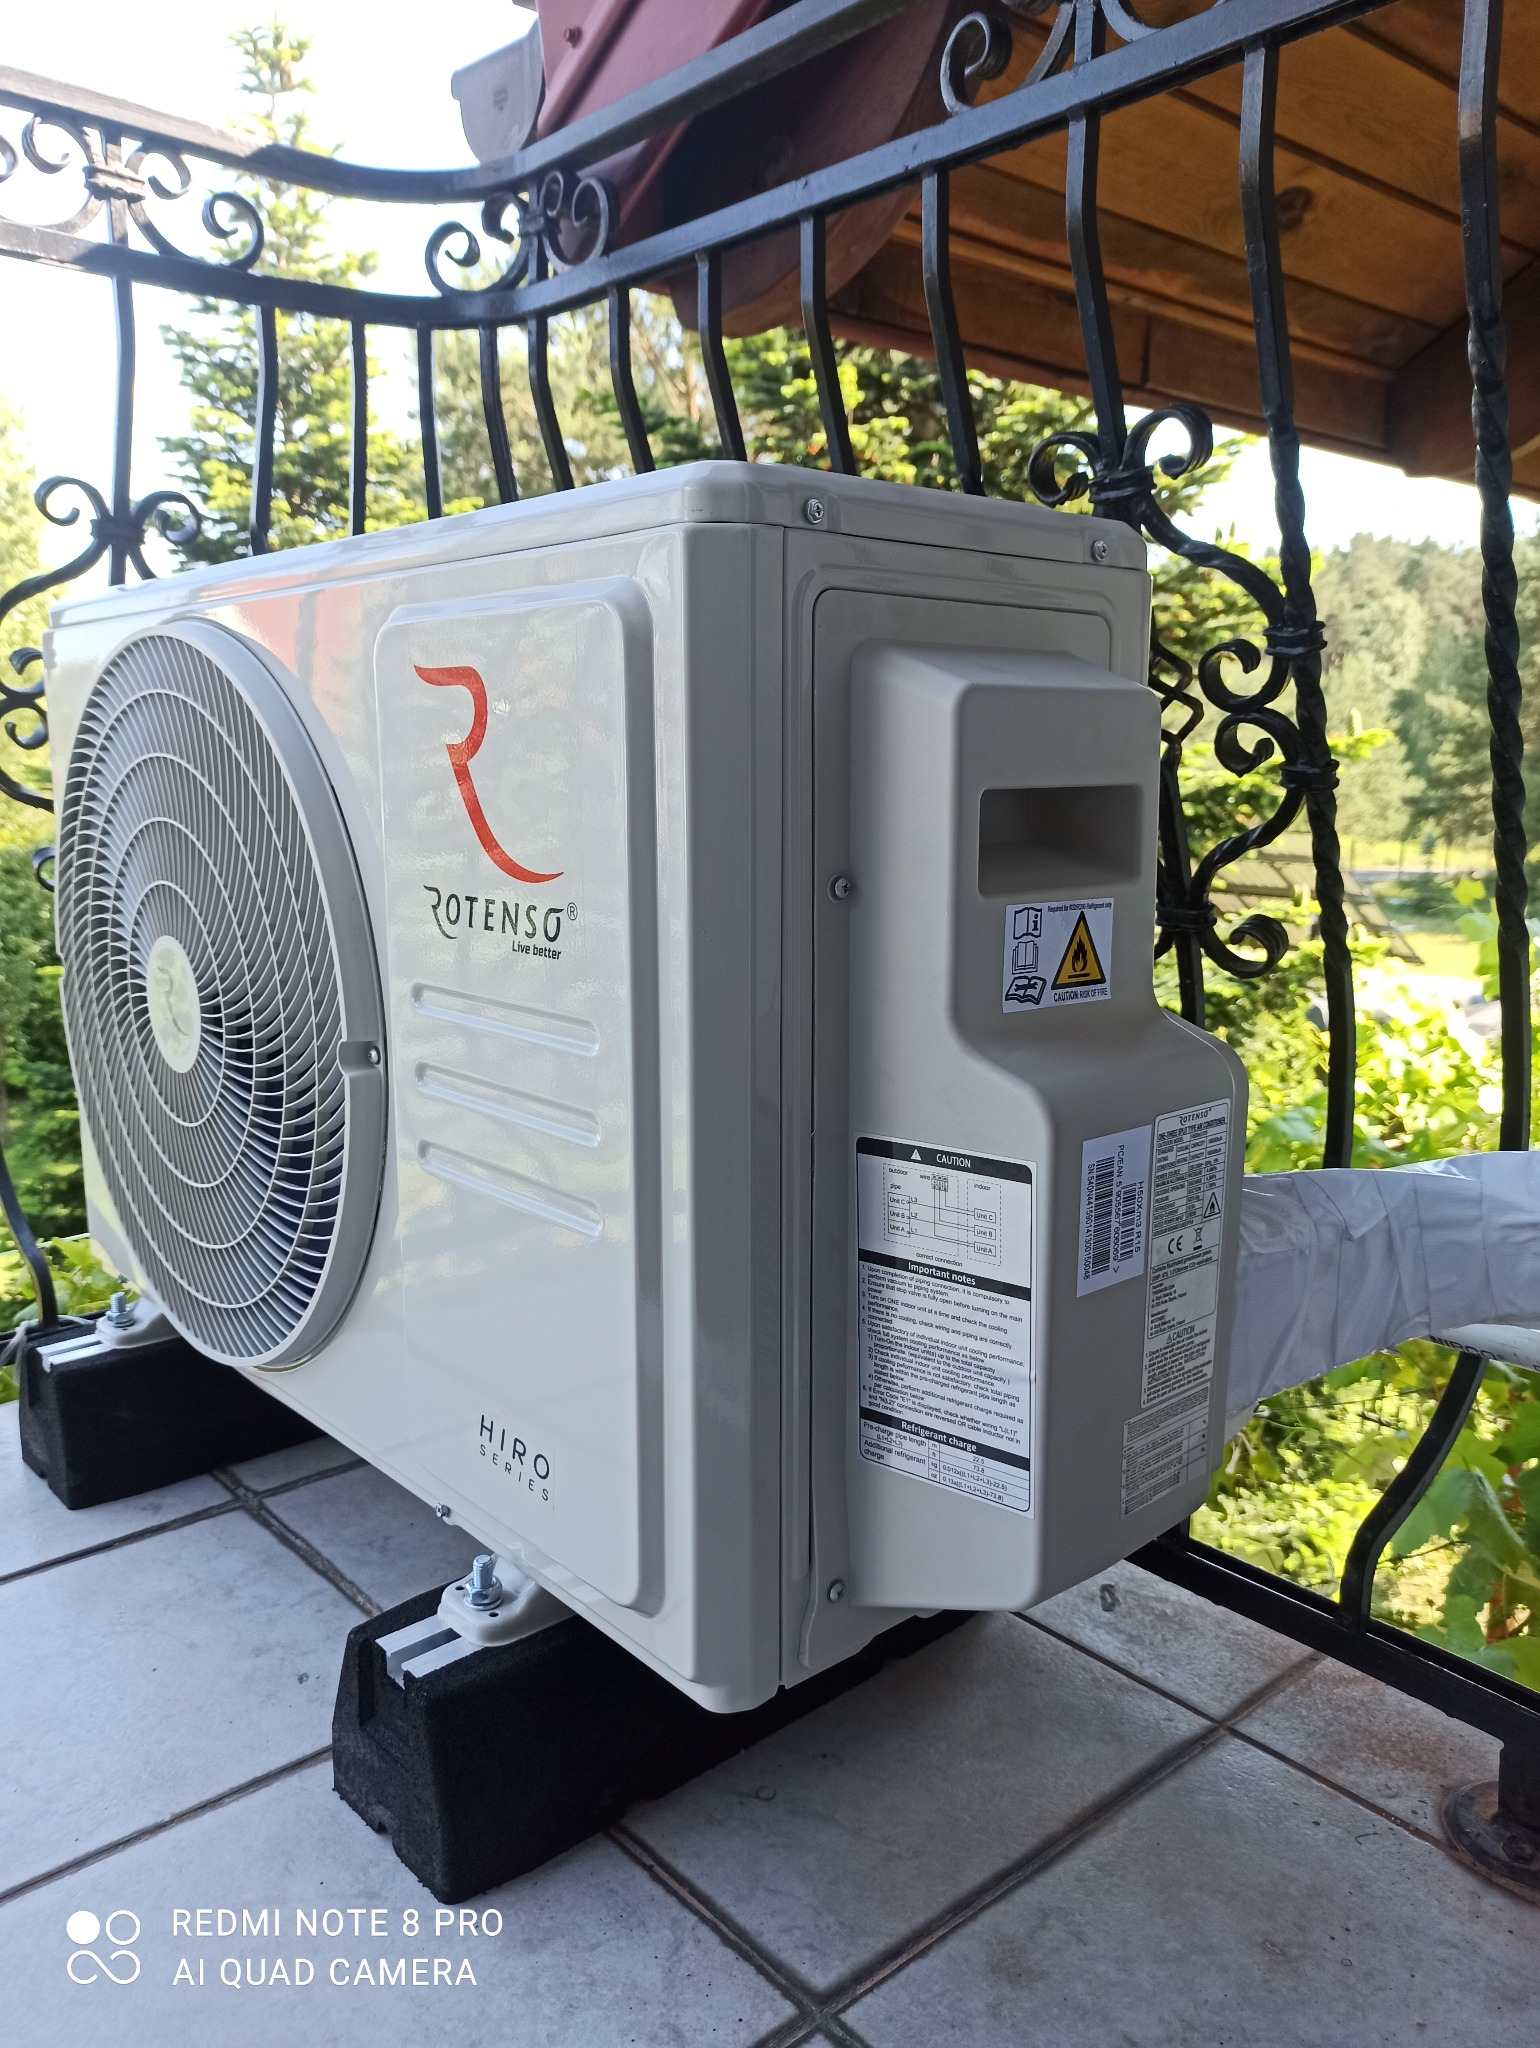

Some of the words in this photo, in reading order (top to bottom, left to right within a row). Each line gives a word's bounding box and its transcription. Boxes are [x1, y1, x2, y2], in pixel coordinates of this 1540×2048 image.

[512, 941, 531, 955] Live
[532, 943, 562, 961] better
[1080, 989, 1091, 999] RISK
[1091, 988, 1098, 998] OF
[1097, 987, 1108, 997] FIRE
[936, 1153, 971, 1169] CAUTION
[1116, 1144, 1125, 1178] PC/EAN
[888, 1167, 908, 1176] outdoor
[920, 1173, 930, 1181] wire
[890, 1182, 901, 1191] pipe
[974, 1182, 991, 1192] indoor
[1116, 1180, 1123, 1188] 5
[889, 1196, 900, 1204] Unit
[1135, 1180, 1144, 1229] H50Xm3
[890, 1210, 900, 1218] Unit
[976, 1212, 987, 1220] Unit
[890, 1223, 900, 1232] Unit
[976, 1228, 987, 1237] Unit
[1134, 1230, 1142, 1254] R15
[976, 1245, 987, 1253] Unit
[916, 1251, 934, 1261] correct
[934, 1256, 963, 1268] connection
[908, 1261, 950, 1281] Important
[952, 1271, 976, 1287] notes
[1172, 1323, 1195, 1341] CAUTION
[863, 1421, 894, 1438] Pre-charge
[895, 1431, 908, 1443] pipe
[908, 1435, 926, 1448] length
[901, 1421, 948, 1444] Refrigerant
[949, 1435, 977, 1453] charge
[479, 1414, 550, 1480] HIRO
[863, 1439, 894, 1456] Additional
[894, 1449, 926, 1466] refrigerant
[863, 1448, 884, 1462] charge
[973, 1455, 985, 1465] 22.5
[479, 1444, 549, 1501] SERIES
[973, 1464, 985, 1474] 73.8
